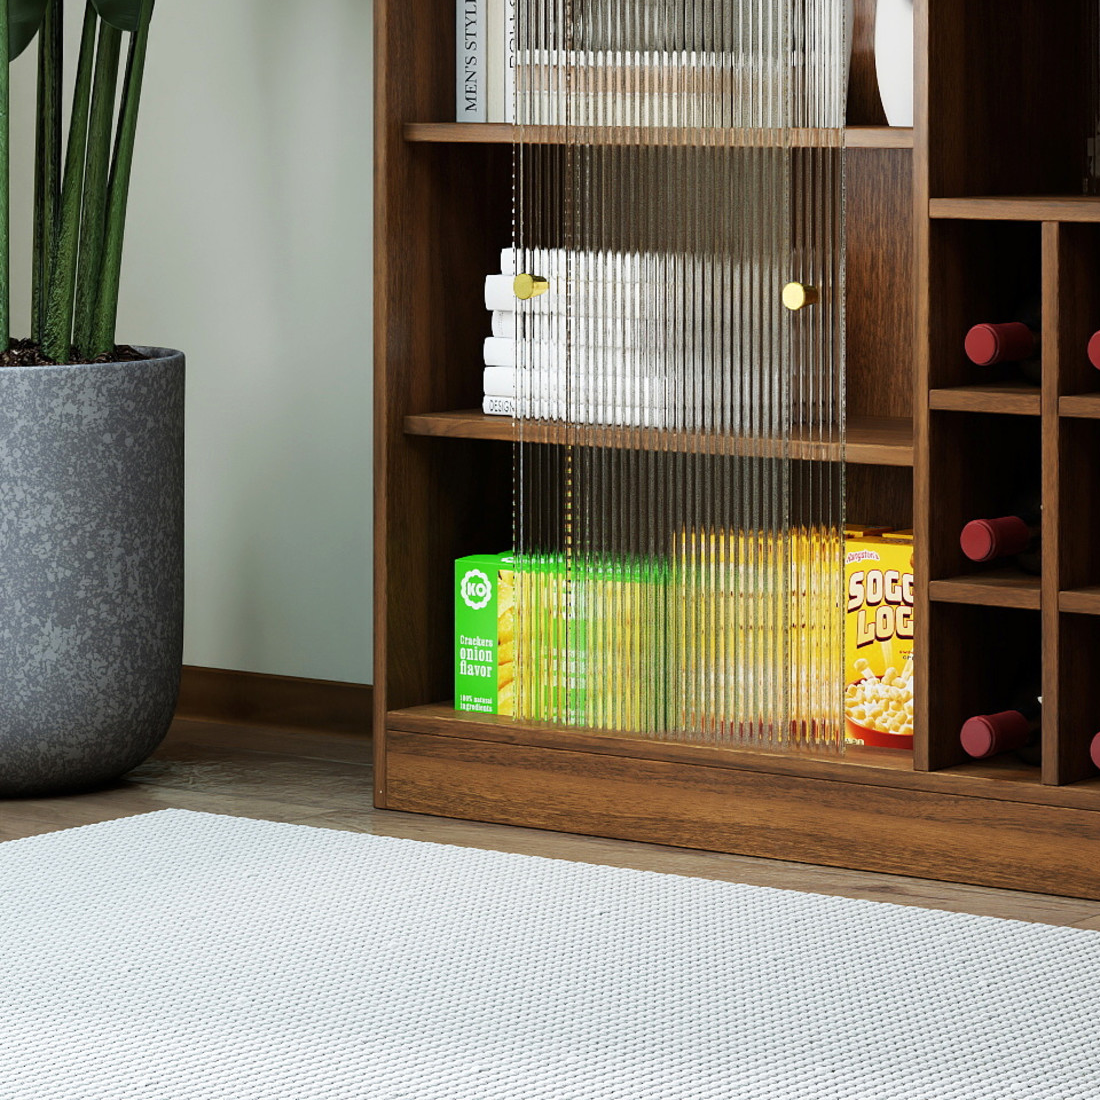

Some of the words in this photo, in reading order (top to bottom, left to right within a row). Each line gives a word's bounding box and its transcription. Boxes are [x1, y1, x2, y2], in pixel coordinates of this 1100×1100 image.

[464, 55, 478, 112] MEN'S
[467, 582, 488, 597] KO
[460, 635, 493, 647] Crackers
[460, 647, 493, 662] onion
[460, 660, 493, 677] flavor
[460, 701, 493, 712] ingredients
